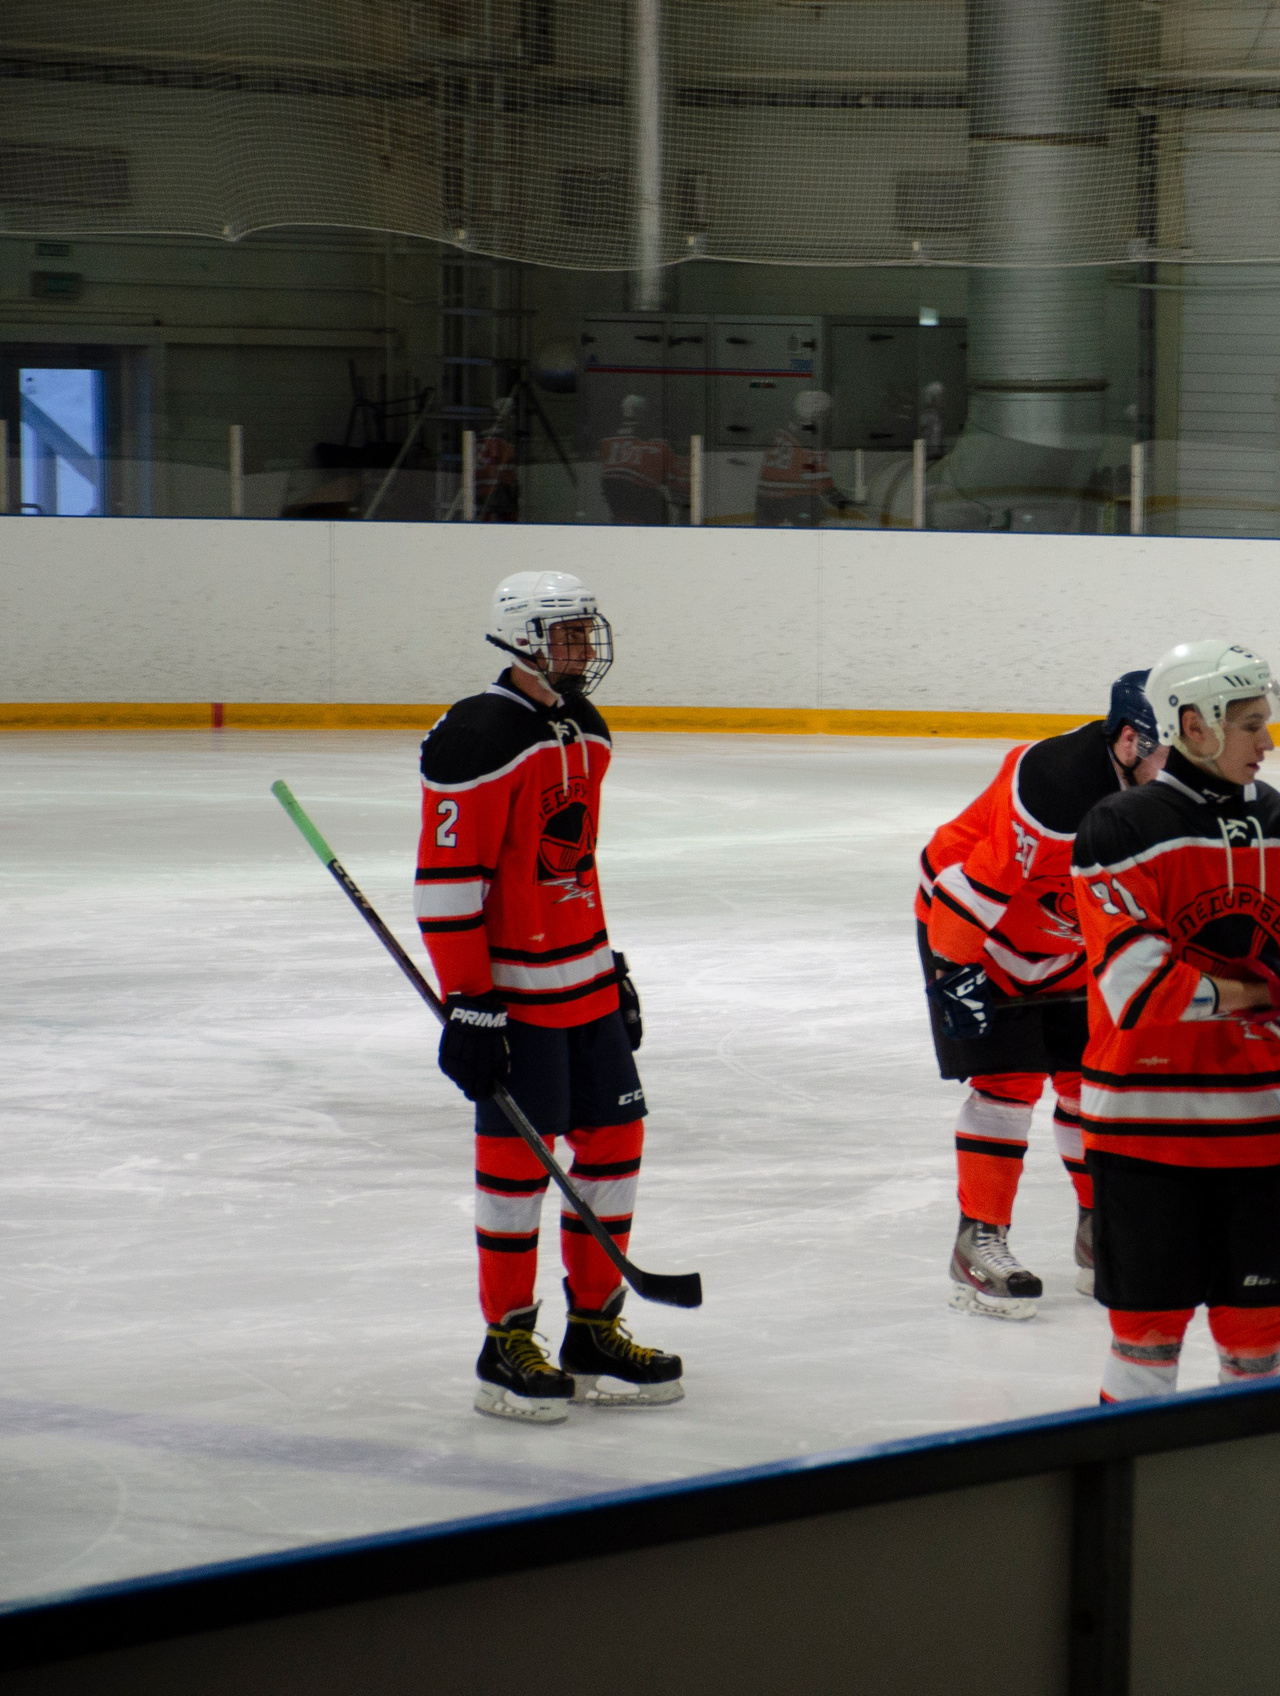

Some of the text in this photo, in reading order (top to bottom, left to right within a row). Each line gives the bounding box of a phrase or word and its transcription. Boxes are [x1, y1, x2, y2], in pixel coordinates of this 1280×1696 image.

[436, 798, 459, 848] 2
[955, 968, 989, 997] CC
[450, 1007, 508, 1028] PRIME
[618, 1088, 645, 1106] CC
